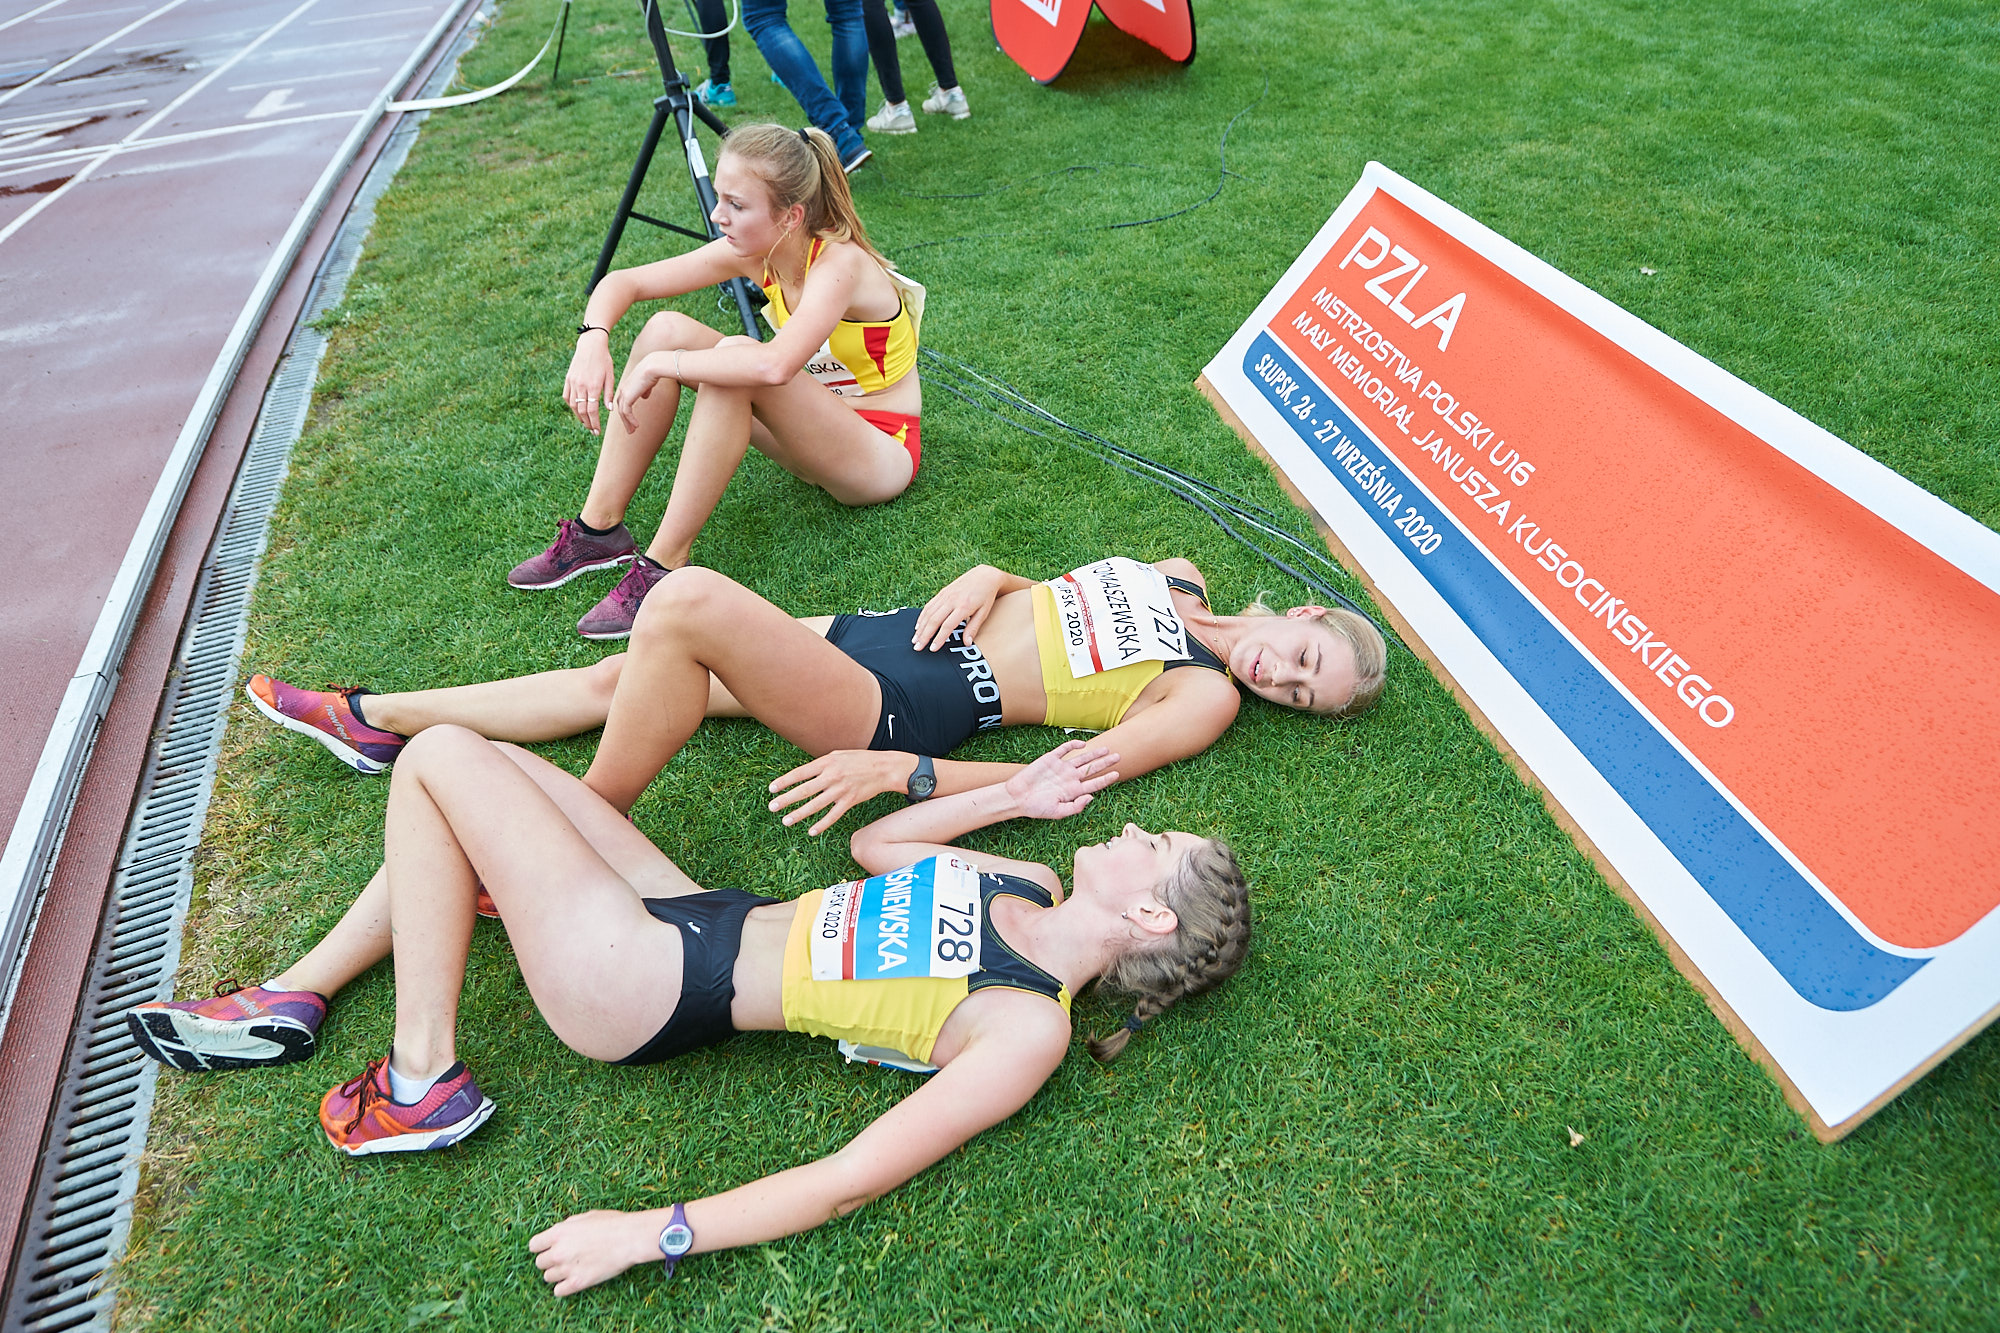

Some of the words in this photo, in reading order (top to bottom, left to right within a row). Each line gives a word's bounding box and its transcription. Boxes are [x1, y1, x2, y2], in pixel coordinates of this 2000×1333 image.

[1338, 225, 1467, 353] PZLA
[1254, 353, 1300, 406] SŁUPSK,
[1311, 286, 1423, 393] MISTRZOSTWA
[1418, 380, 1495, 451] POLSKI
[1488, 440, 1536, 487] U16
[1291, 394, 1316, 421] 26
[1310, 418, 1318, 426] -
[1313, 419, 1342, 444] 27
[1331, 435, 1403, 518] WRZEŚNIA
[1291, 310, 1336, 352] MAŁY
[1327, 345, 1415, 435] MEMORIAŁ
[1411, 429, 1512, 526] JANUSZA
[1506, 513, 1735, 728] KUSOCIŃSKIEGO
[1393, 506, 1443, 555] 2020
[1066, 611, 1084, 647] 2020
[1090, 561, 1141, 661] TOMASZEWSKA
[1148, 606, 1182, 655] 727
[949, 644, 1000, 704] PRO
[822, 910, 842, 939] 2020
[938, 902, 974, 962] 728
